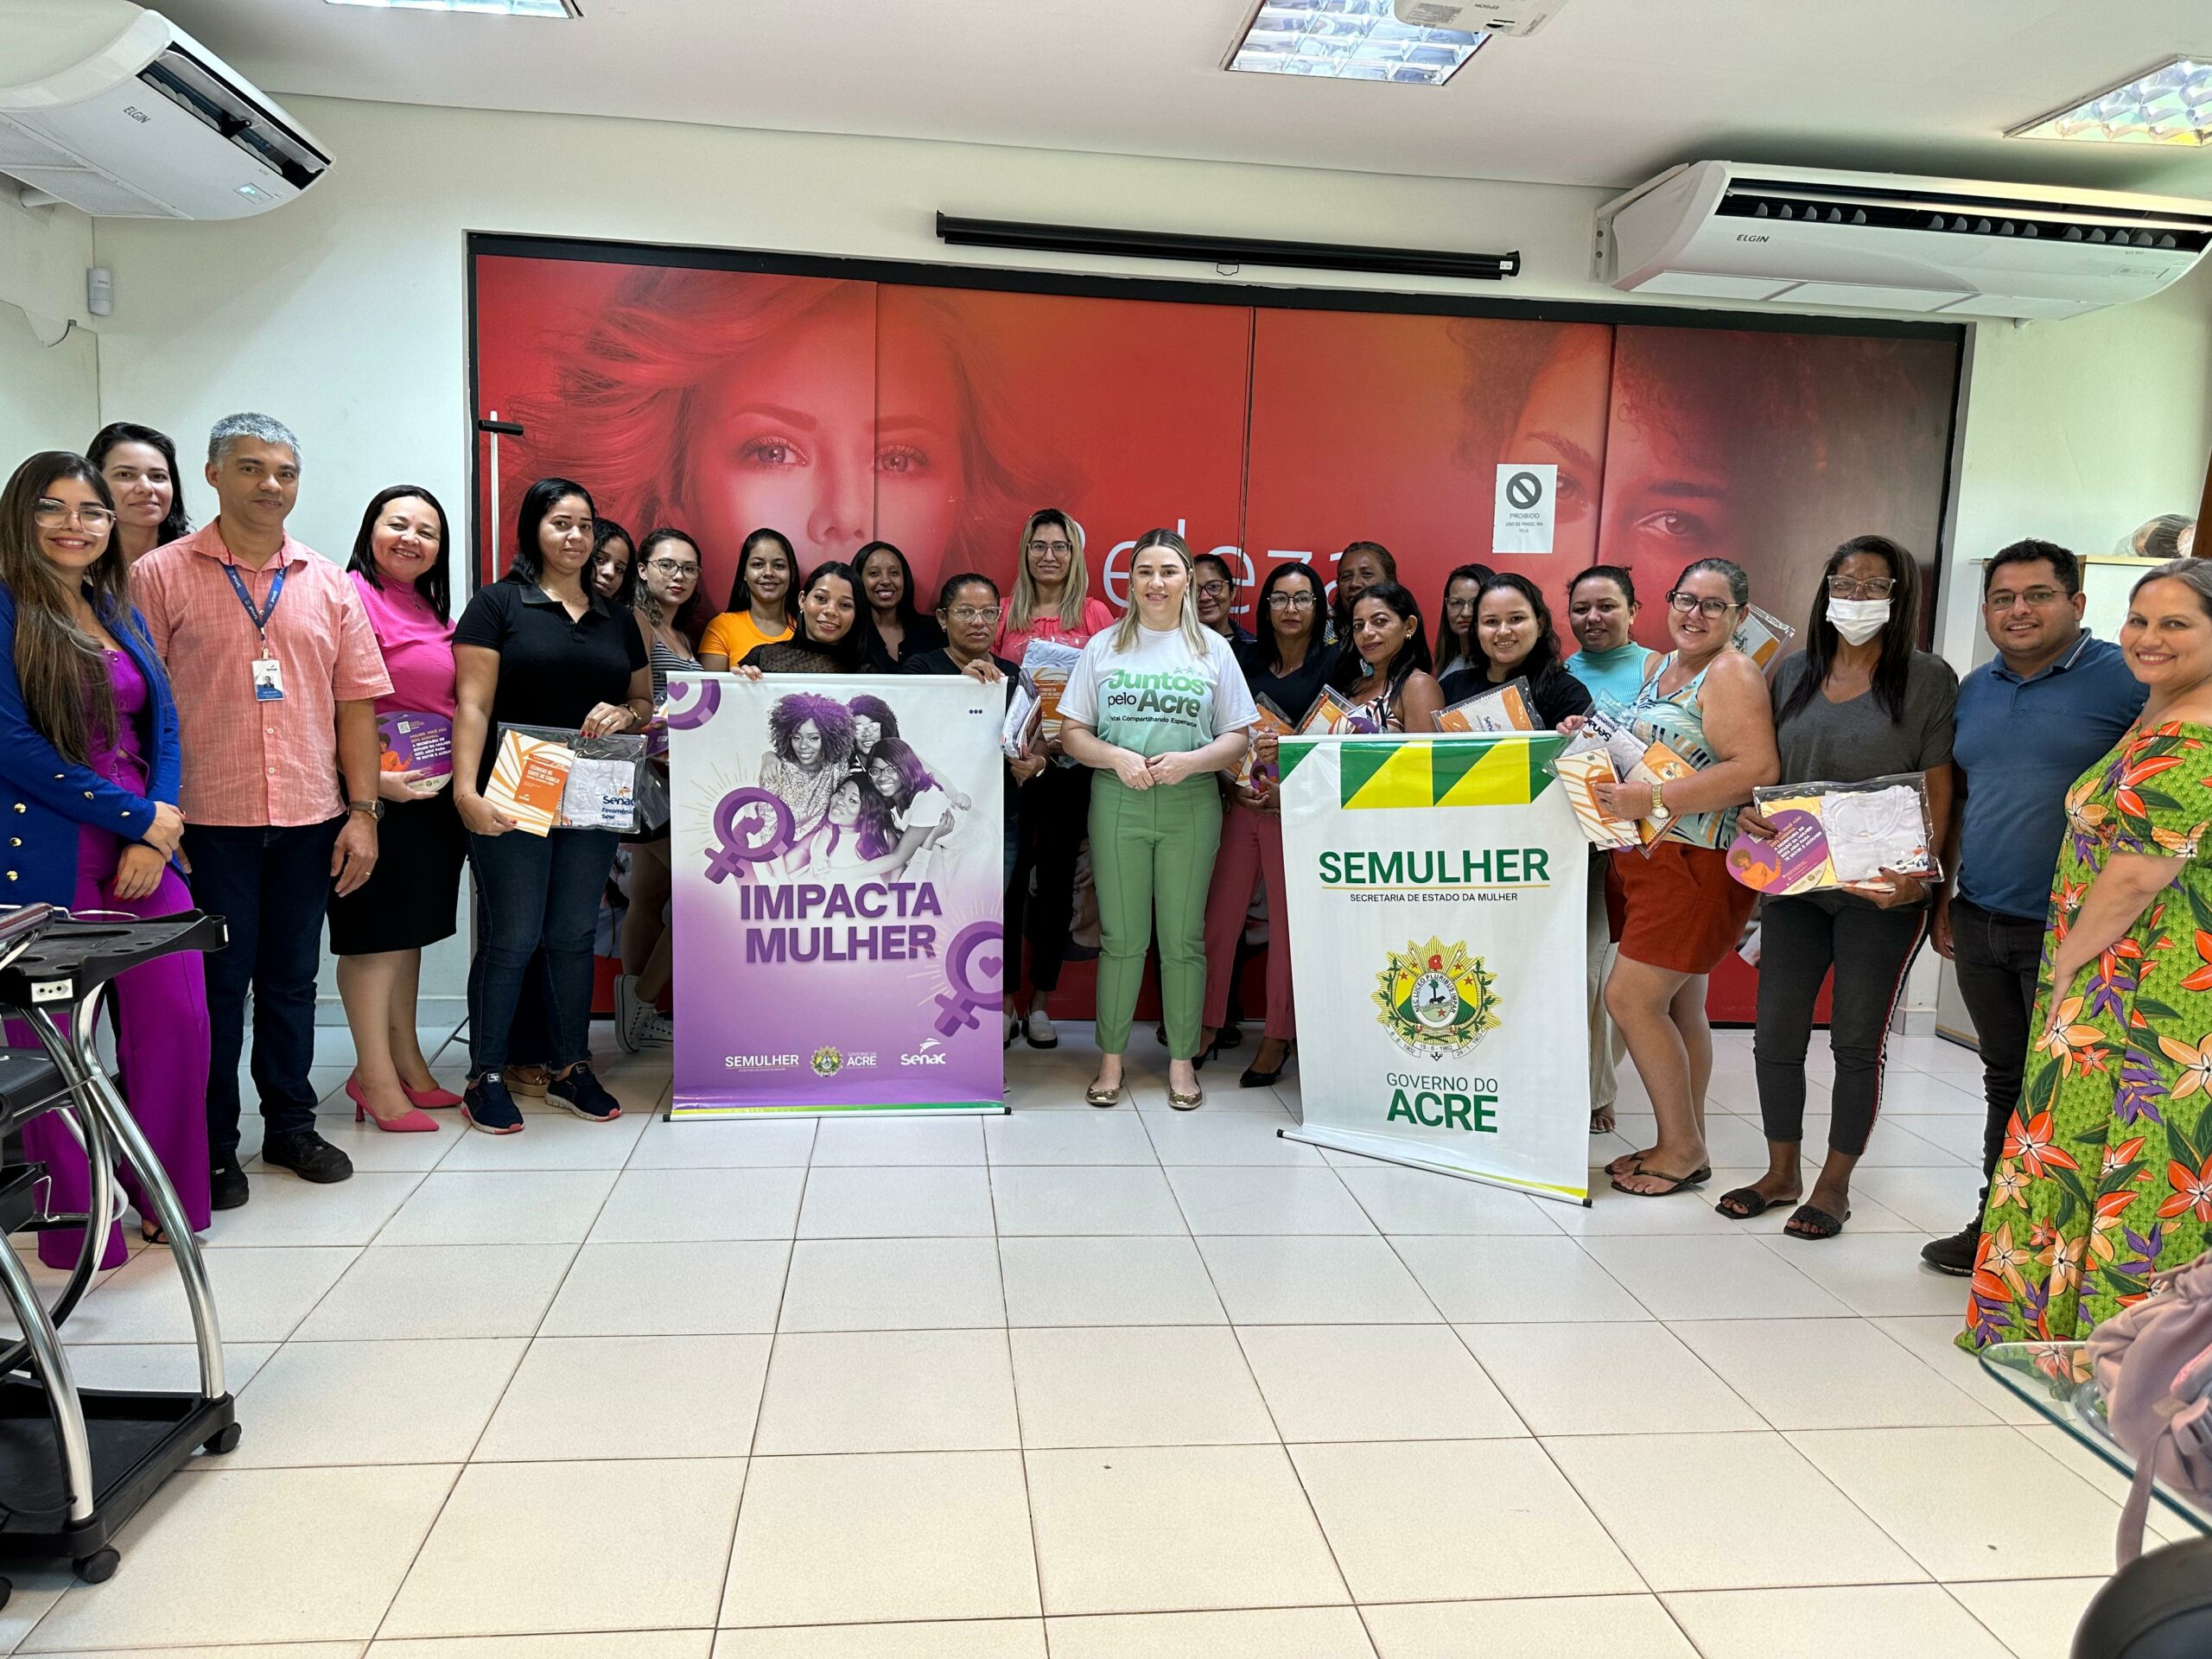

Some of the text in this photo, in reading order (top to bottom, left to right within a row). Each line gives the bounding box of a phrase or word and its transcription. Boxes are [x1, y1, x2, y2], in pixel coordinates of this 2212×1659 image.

[124, 106, 151, 123] ELGIN
[1109, 670, 1205, 696] Juntos
[1108, 690, 1201, 717] pelo Acre
[1583, 716, 1611, 741] Senac
[603, 796, 636, 805] Senac
[1319, 848, 1550, 884] SEMULHER
[741, 881, 942, 920] IMPACTA
[1350, 893, 1517, 902] SECRETARIA DE ESTADO DA MULHER
[747, 925, 937, 963] MULHER
[1414, 977, 1425, 998] LUCEO
[1425, 974, 1454, 993] PLURIBUS
[725, 1054, 799, 1067] SEMULHER
[847, 1056, 877, 1066] ACRE
[1387, 1072, 1497, 1093] GOVERNO DO
[1386, 1088, 1498, 1133] ACRE
